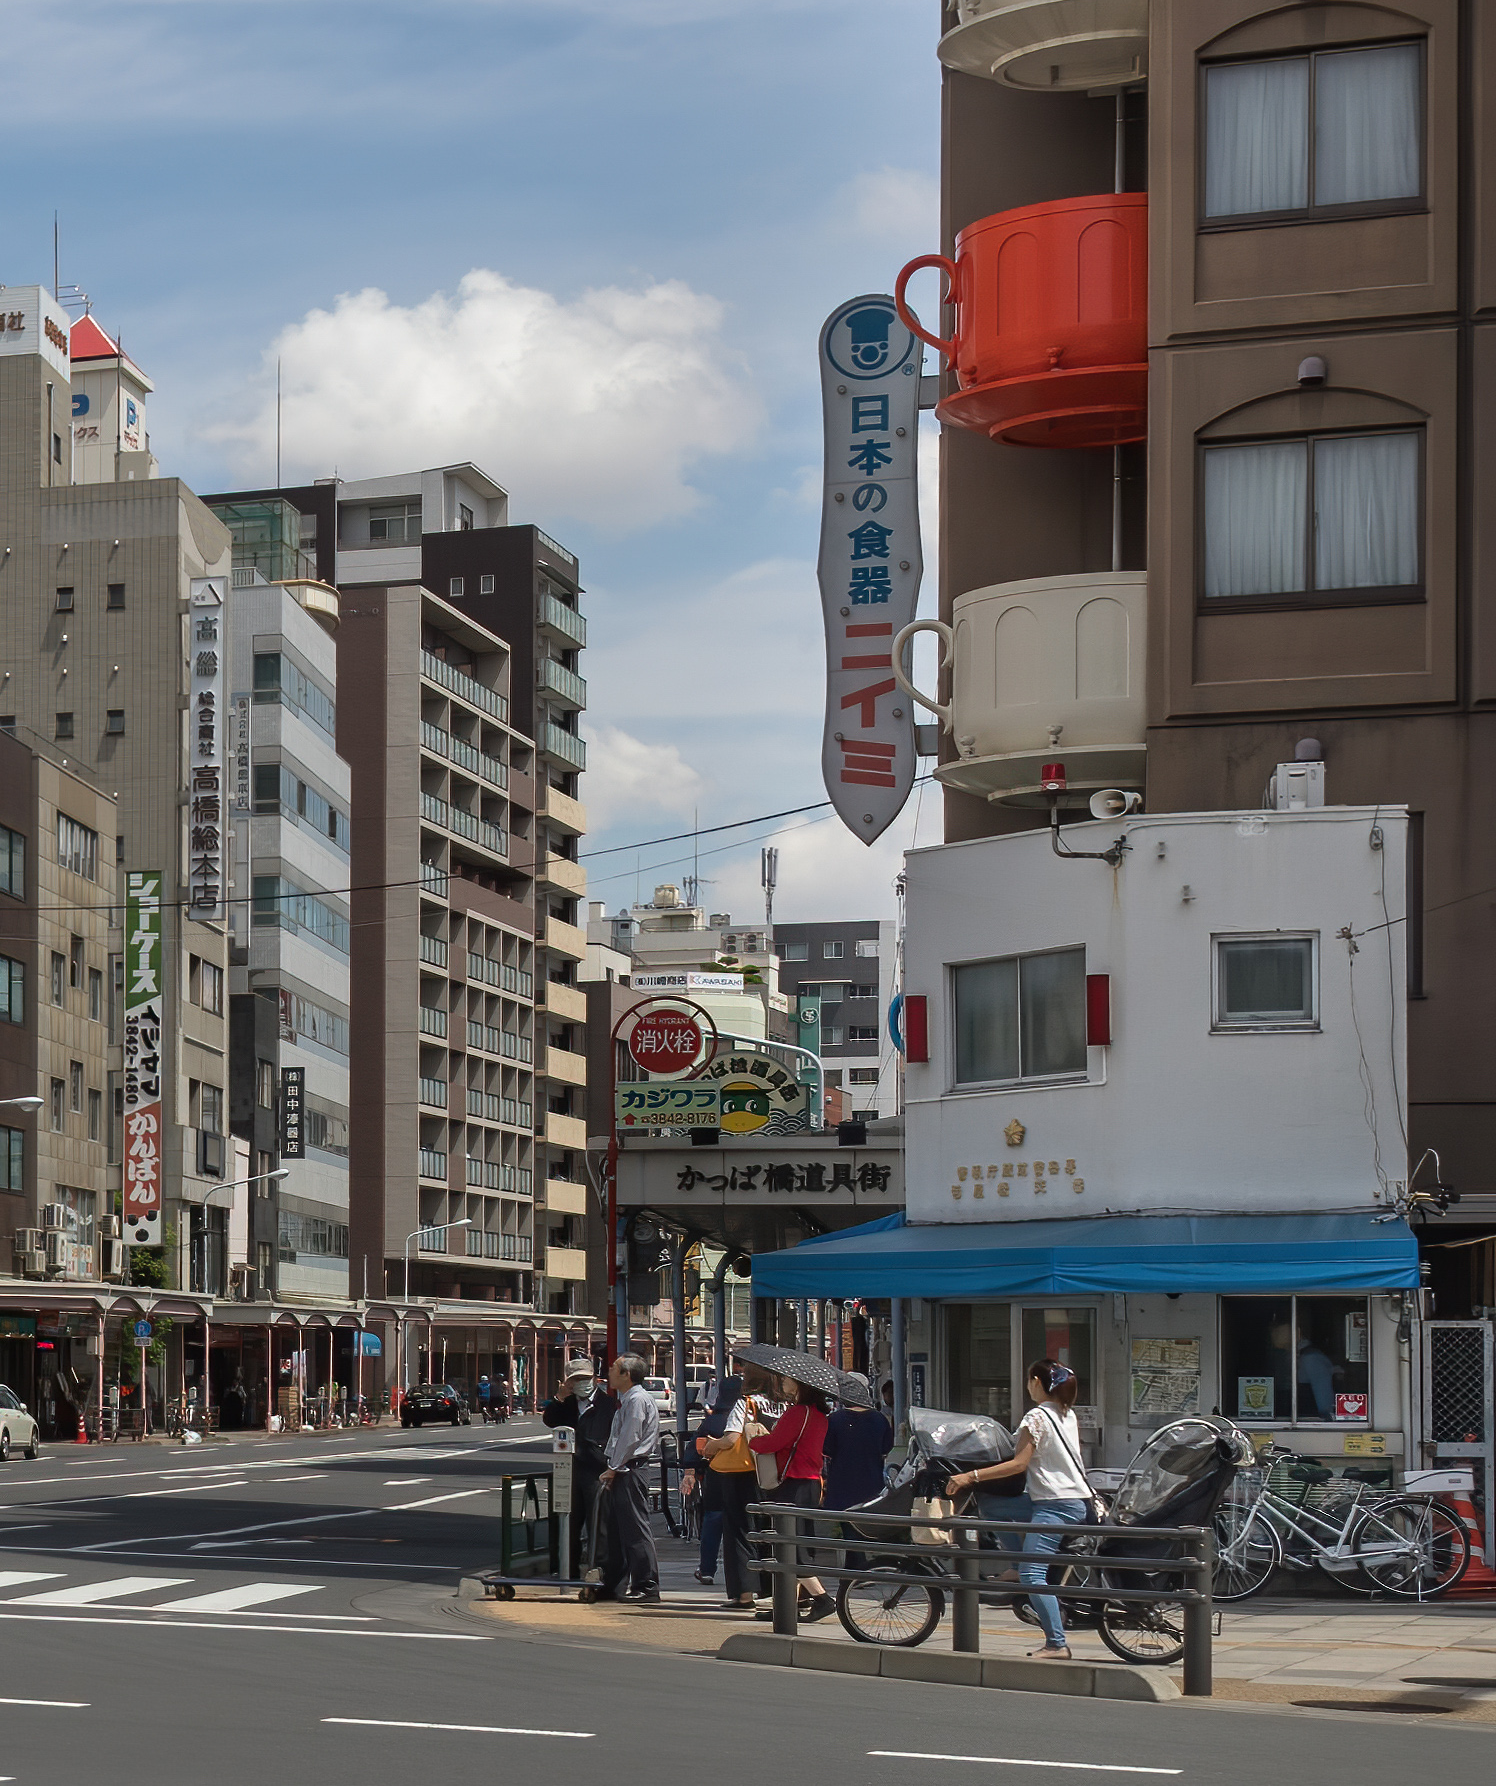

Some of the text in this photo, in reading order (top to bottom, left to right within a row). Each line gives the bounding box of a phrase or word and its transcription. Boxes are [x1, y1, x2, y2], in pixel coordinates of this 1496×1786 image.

[840, 394, 896, 789] 日本の食器 ニイミ
[129, 873, 160, 994] ショーケース
[125, 1015, 139, 1104] 3842-1480
[636, 1028, 696, 1054] 消火栓
[621, 1088, 717, 1109] カジワラ
[127, 1113, 160, 1204] かんばん
[676, 1162, 892, 1195] かっぱ橋道具街
